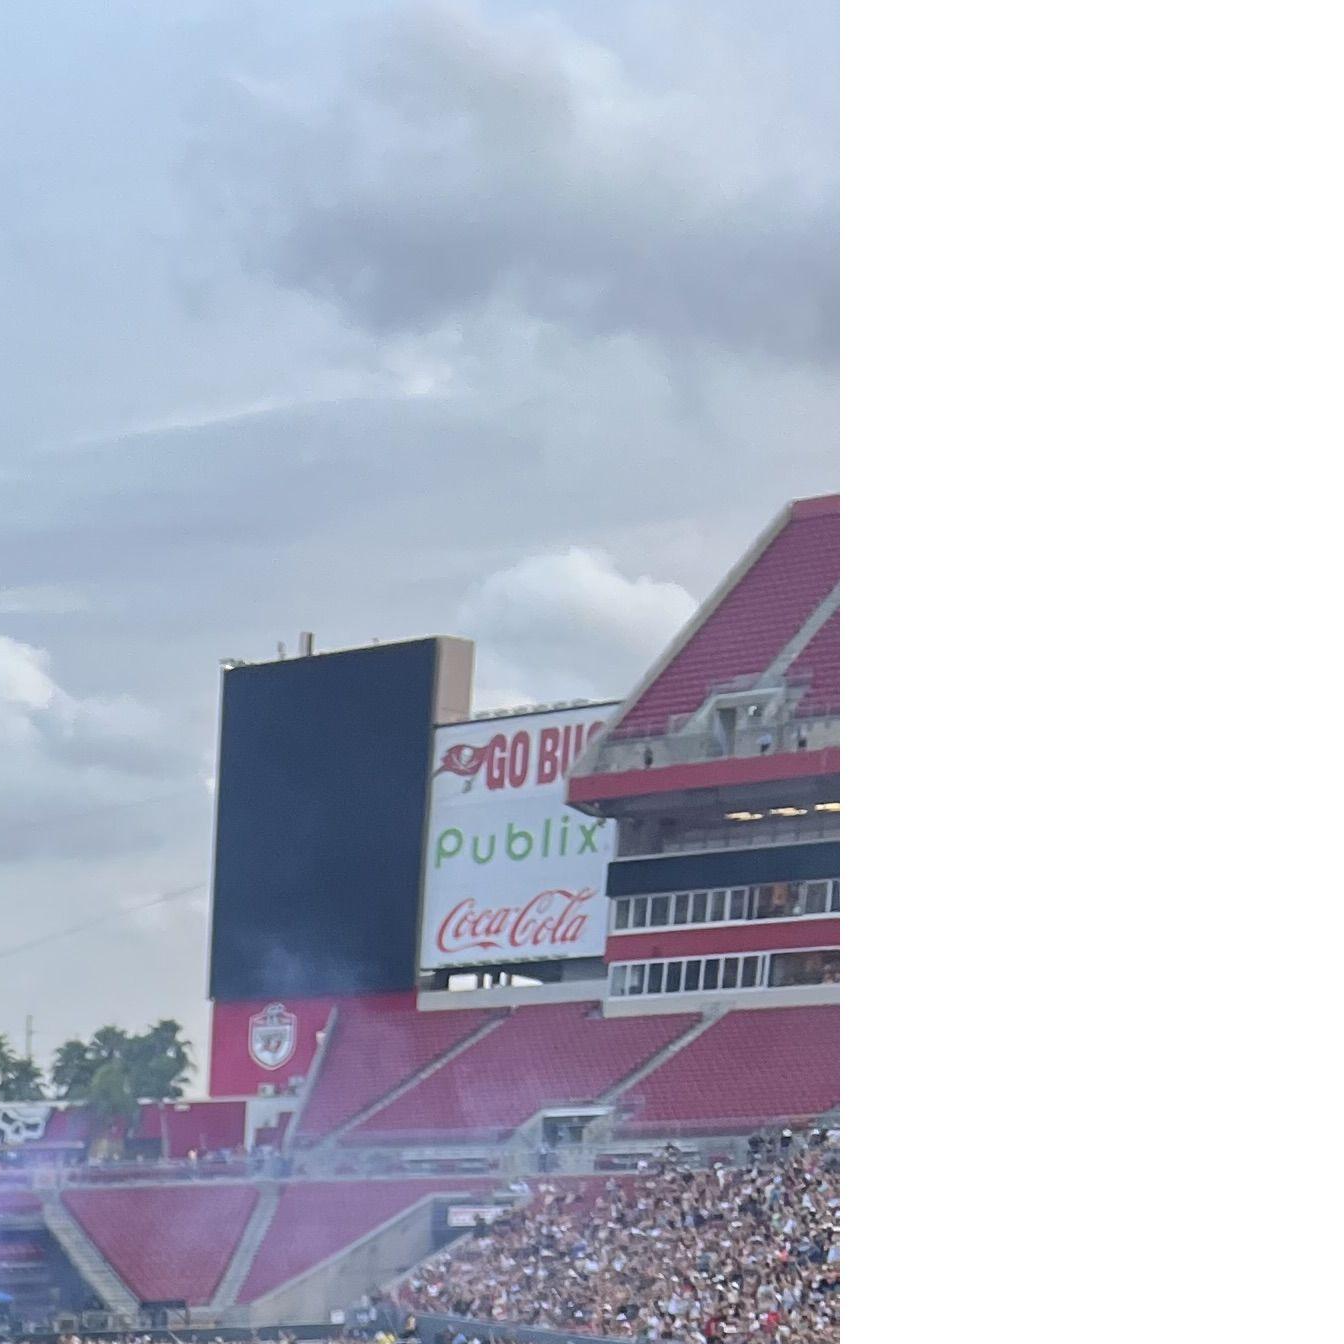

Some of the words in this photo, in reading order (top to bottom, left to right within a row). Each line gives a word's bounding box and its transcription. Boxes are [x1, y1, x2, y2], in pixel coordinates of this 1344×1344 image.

[486, 730, 531, 790] GO
[435, 816, 599, 869] Publix
[437, 888, 598, 953] Coca-Cola
